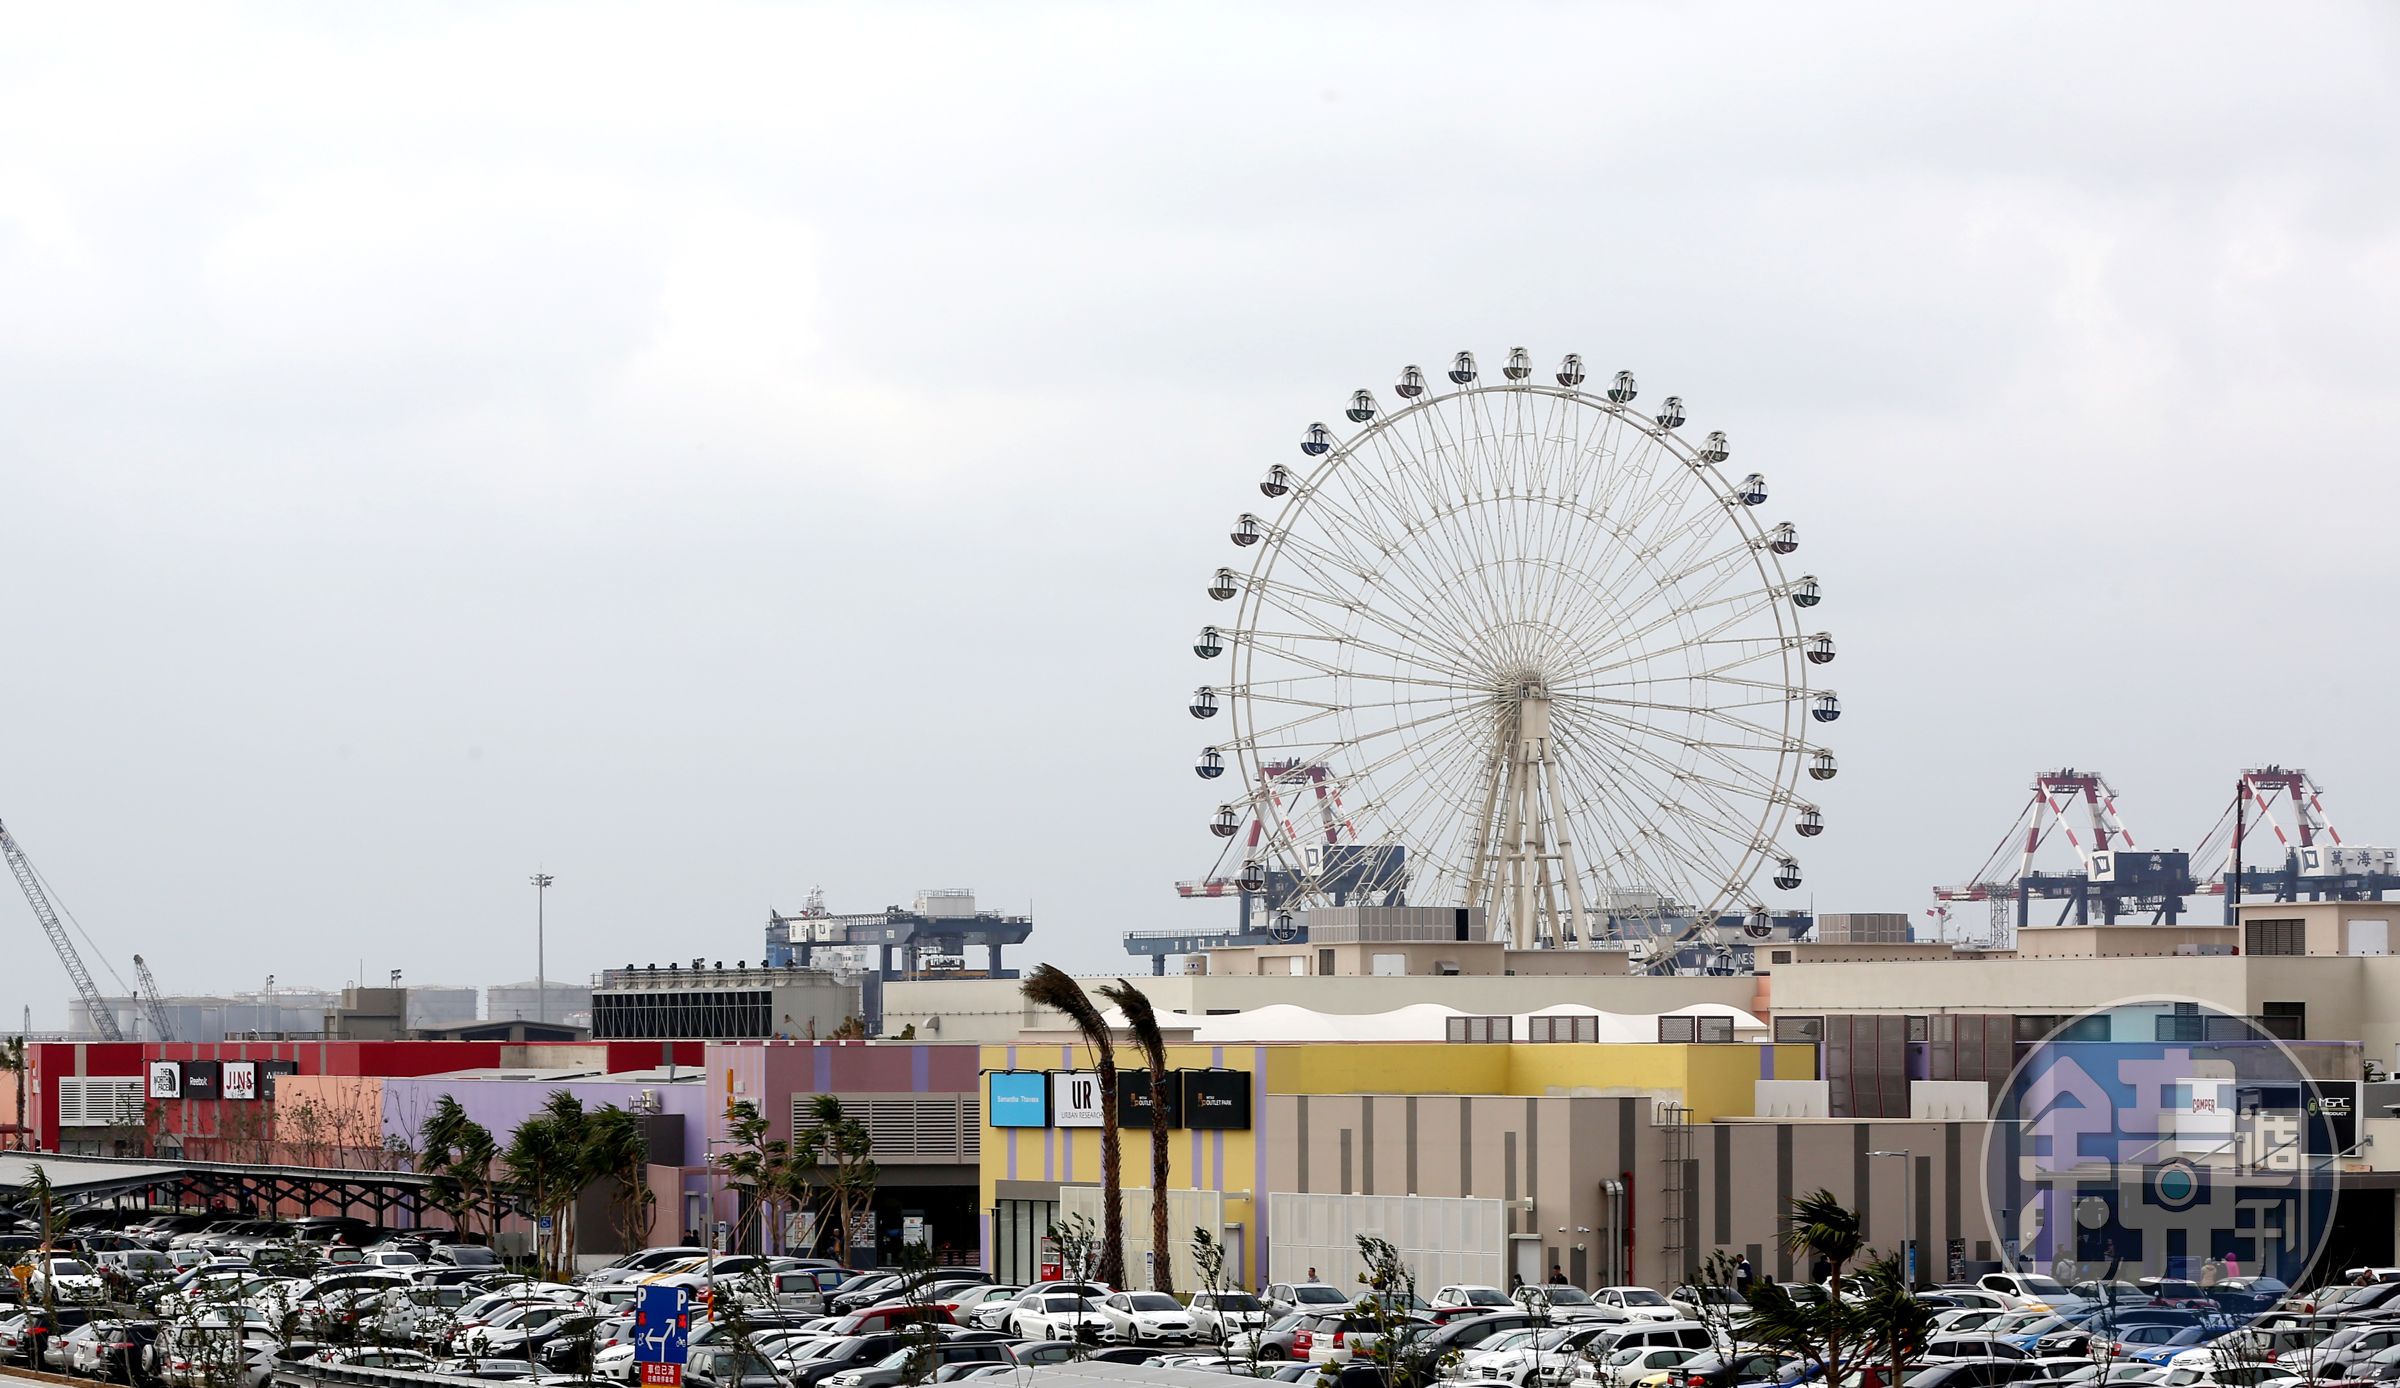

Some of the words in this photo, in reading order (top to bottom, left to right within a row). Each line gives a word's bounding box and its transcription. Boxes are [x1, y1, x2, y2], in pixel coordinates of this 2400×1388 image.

[2331, 850, 2372, 867] 萬海
[190, 1077, 208, 1086] Reebok
[226, 1072, 253, 1090] JINS
[1072, 1080, 1092, 1109] UR
[2318, 1097, 2350, 1108] MSPC
[2192, 1098, 2216, 1114] CAMPER
[1061, 1111, 1078, 1119] URBAN
[638, 1288, 646, 1308] P
[677, 1290, 686, 1312] P
[648, 1364, 674, 1376] 車位已滿
